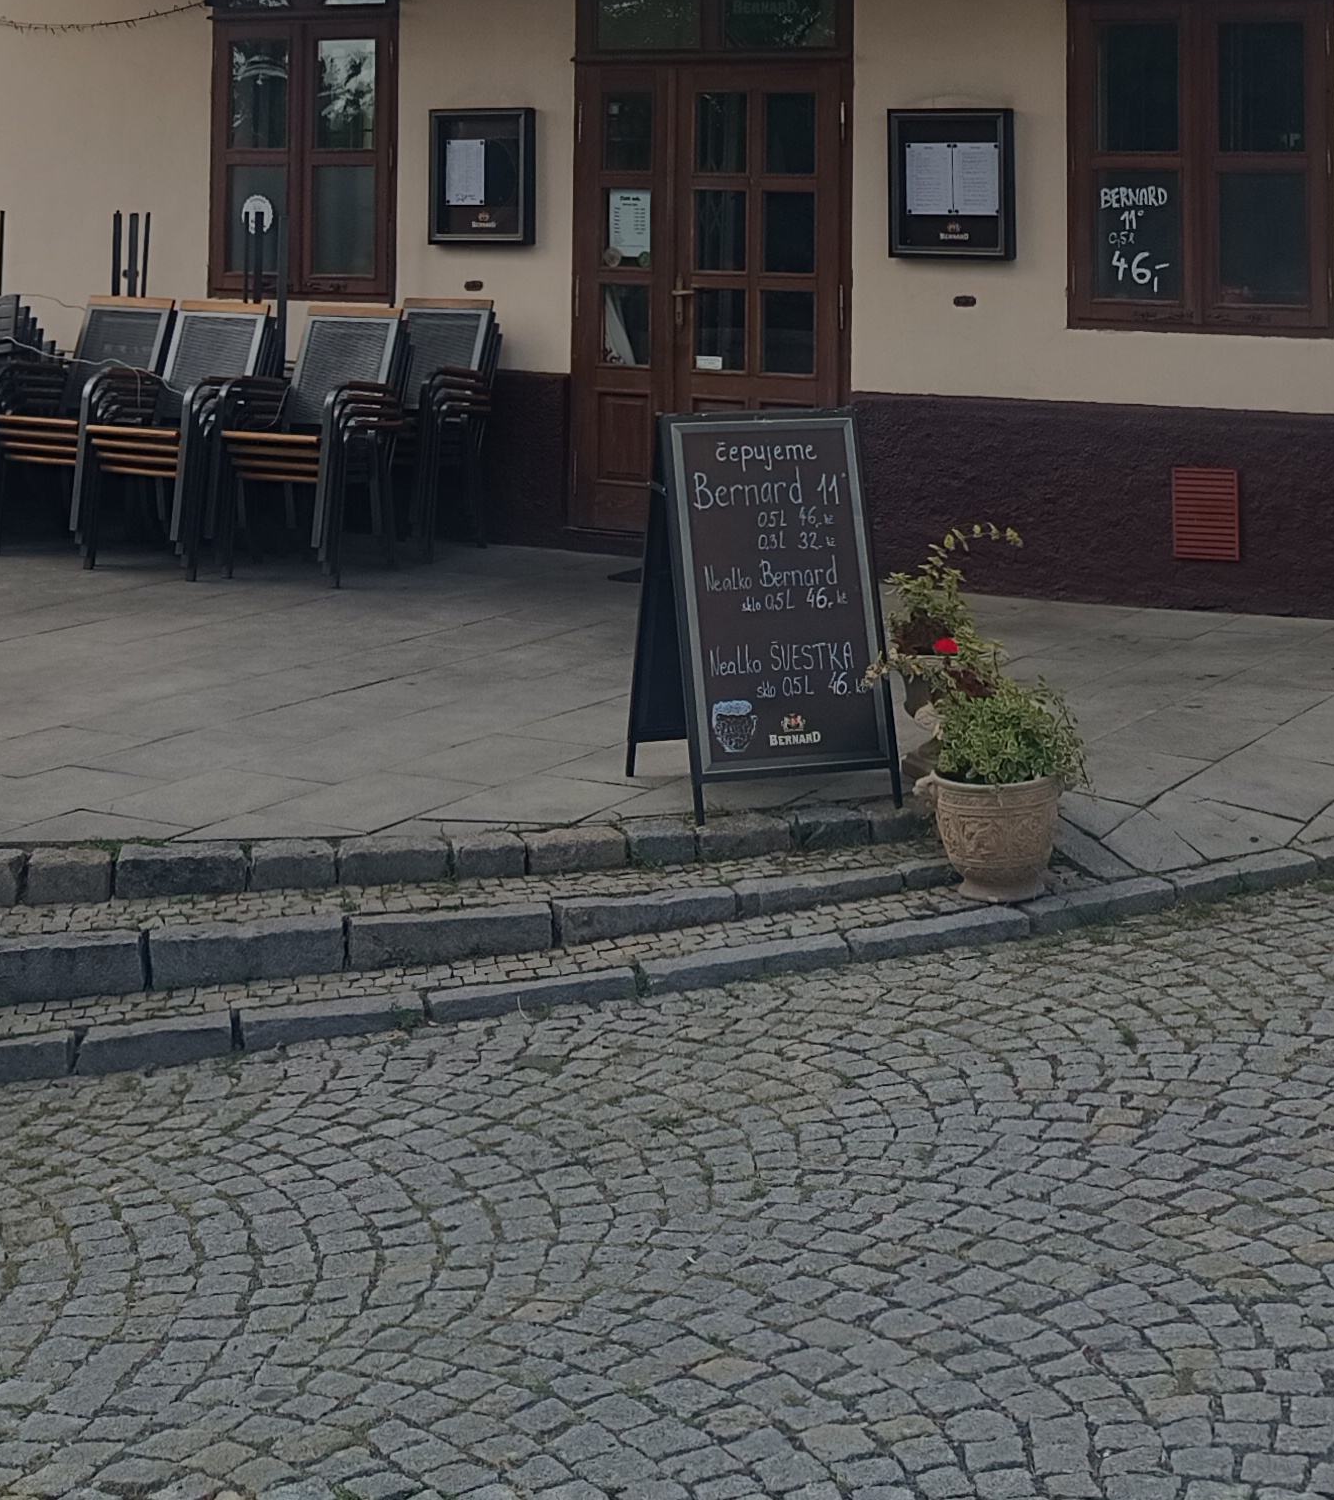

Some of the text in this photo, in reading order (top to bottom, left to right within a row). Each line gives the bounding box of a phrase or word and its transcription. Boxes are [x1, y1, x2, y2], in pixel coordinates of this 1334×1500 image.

[1100, 186, 1168, 209] BERNARD
[1120, 210, 1144, 230] 11°
[1112, 251, 1170, 293] 46,-
[716, 442, 817, 472] čepujeme
[693, 466, 803, 510] Bernard
[758, 555, 838, 588] Bernard
[769, 640, 855, 671] ŠVESTKA
[769, 731, 822, 747] BERNARD
